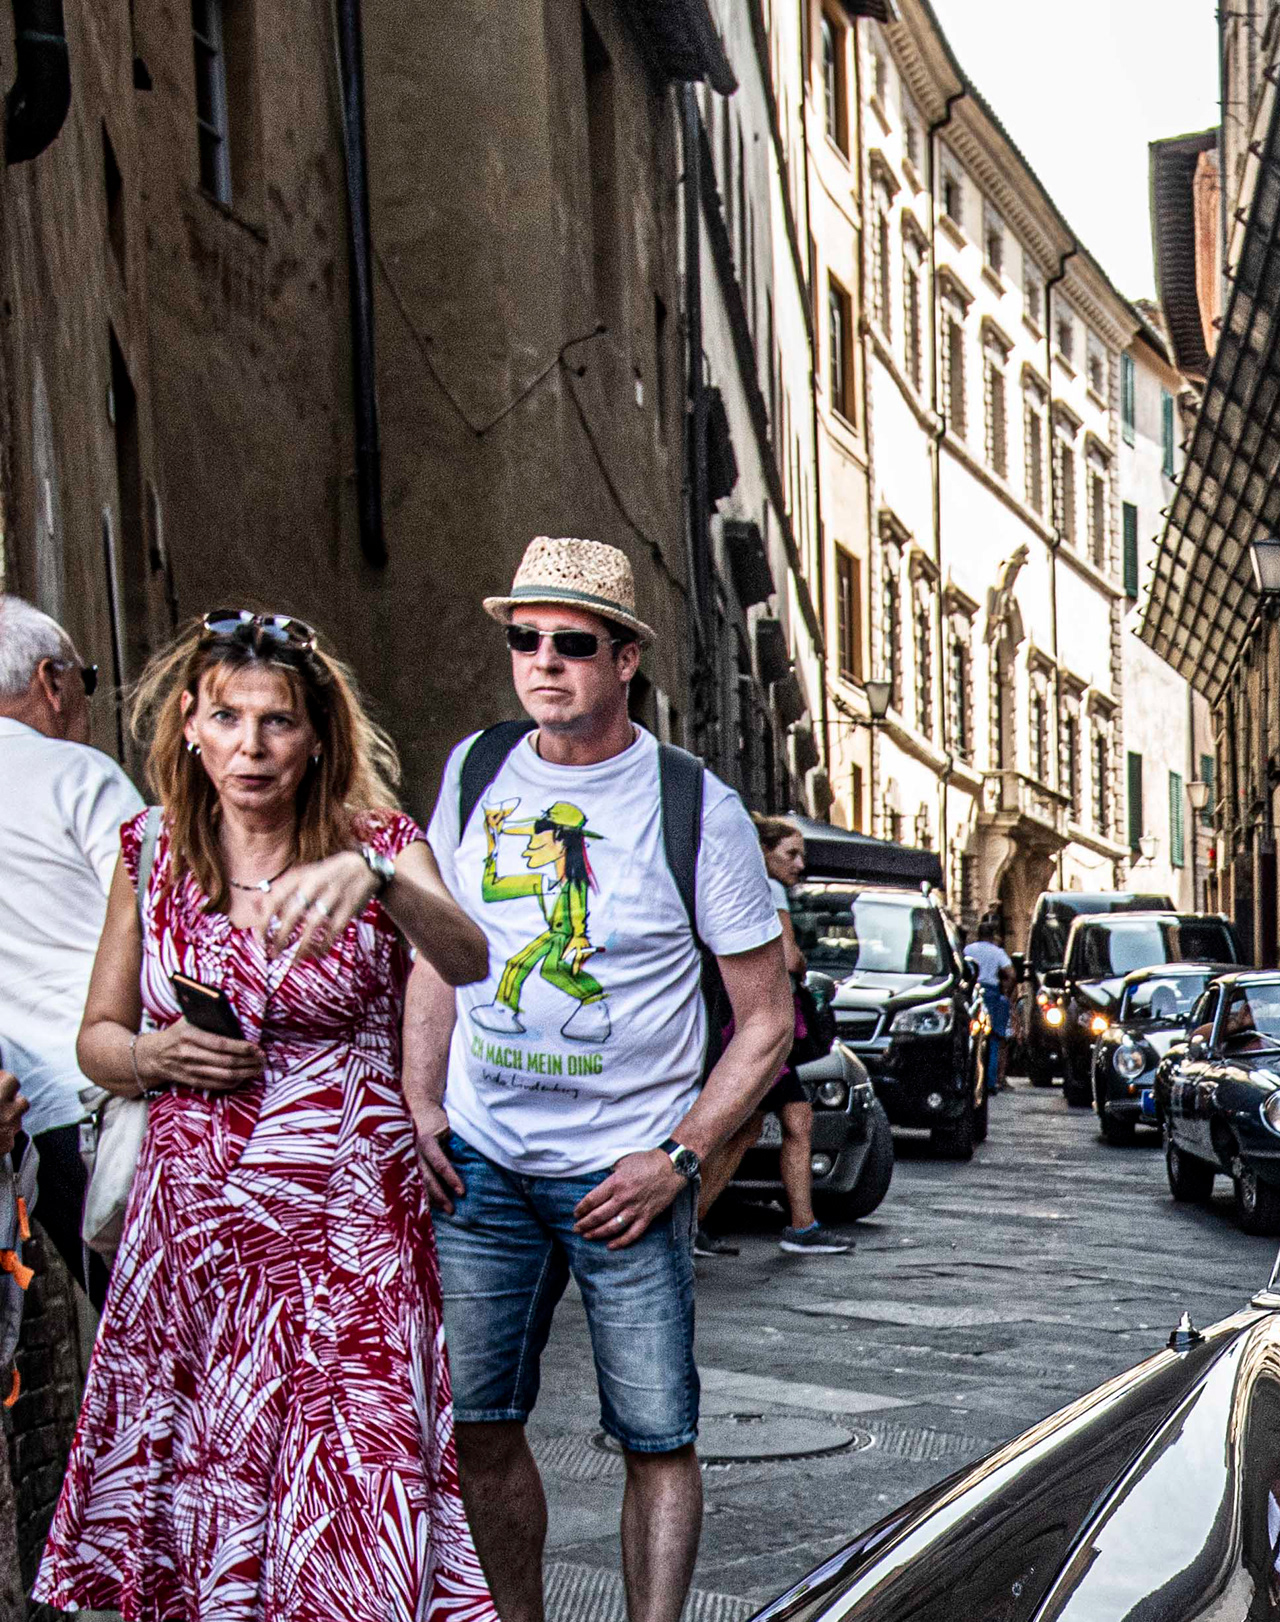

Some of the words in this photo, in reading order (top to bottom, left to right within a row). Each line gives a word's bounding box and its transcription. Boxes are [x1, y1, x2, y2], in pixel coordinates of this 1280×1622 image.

[485, 1042, 523, 1071] MACH
[526, 1052, 563, 1076] MEIN
[567, 1053, 603, 1076] DING
